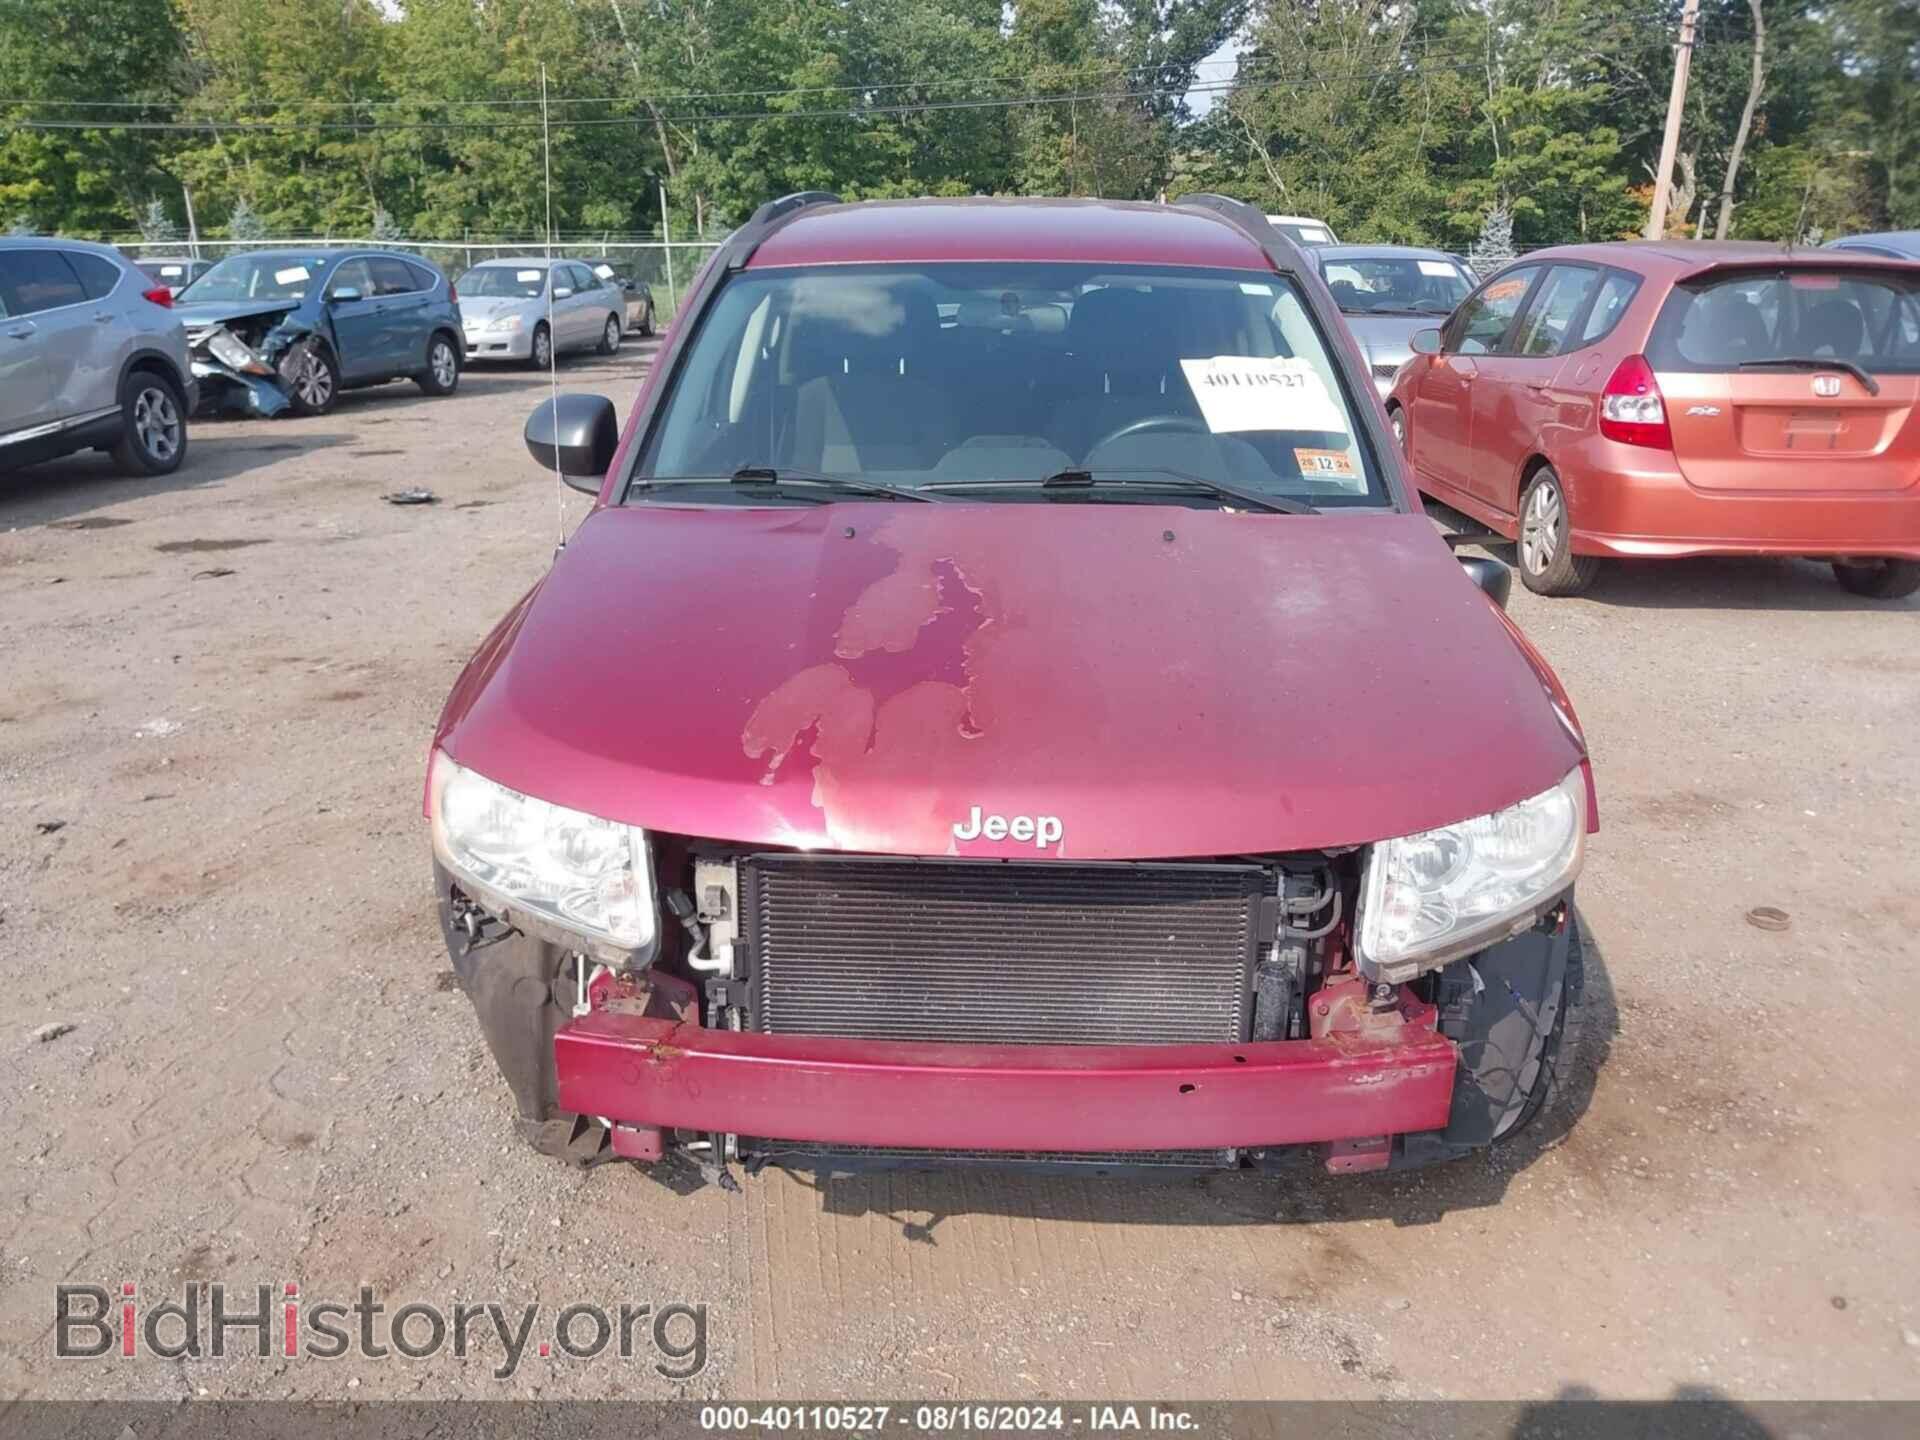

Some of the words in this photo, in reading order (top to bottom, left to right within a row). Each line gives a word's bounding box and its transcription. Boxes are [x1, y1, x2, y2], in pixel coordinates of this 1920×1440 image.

[1203, 373, 1305, 388] 40110527
[1318, 457, 1334, 470] 12
[953, 806, 1063, 848] Jeep
